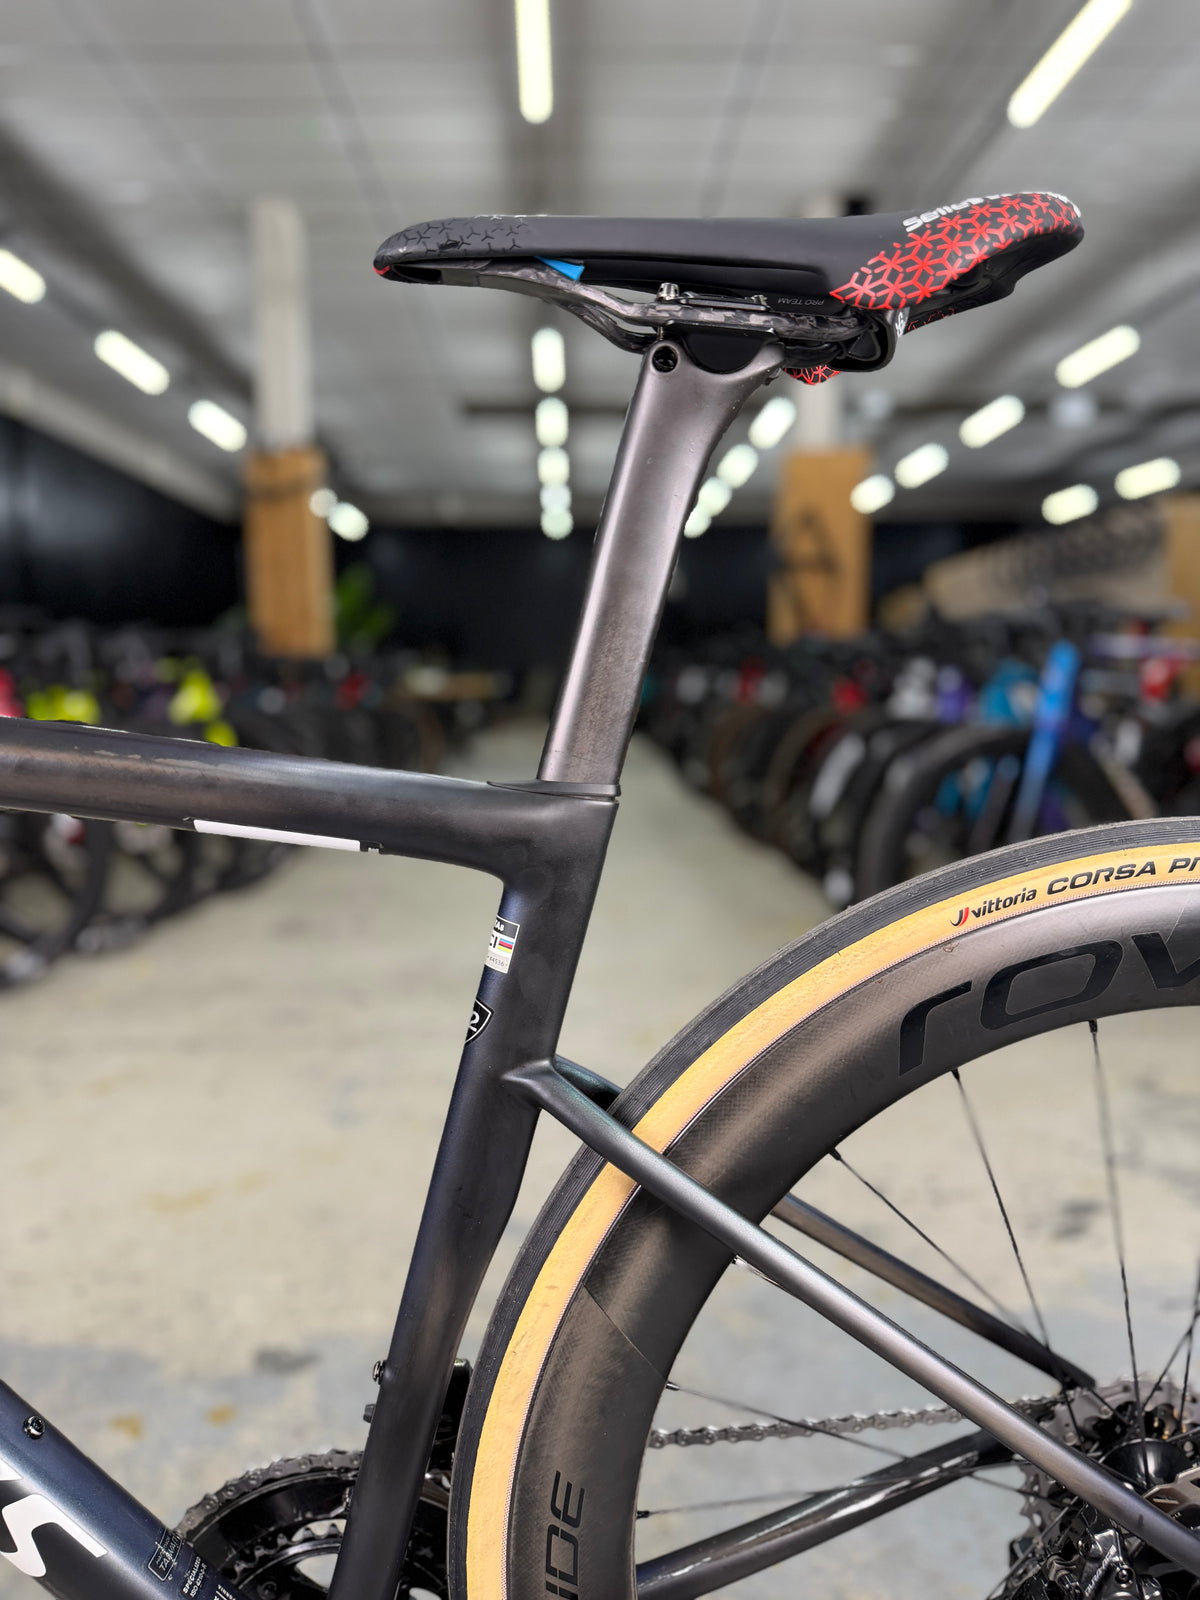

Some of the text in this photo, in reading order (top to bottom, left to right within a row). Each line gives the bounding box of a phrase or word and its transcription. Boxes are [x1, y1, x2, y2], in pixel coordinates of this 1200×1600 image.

[777, 297, 825, 306] PRO TEAM
[1046, 861, 1156, 896] CORSA
[971, 887, 1037, 918] vittoria
